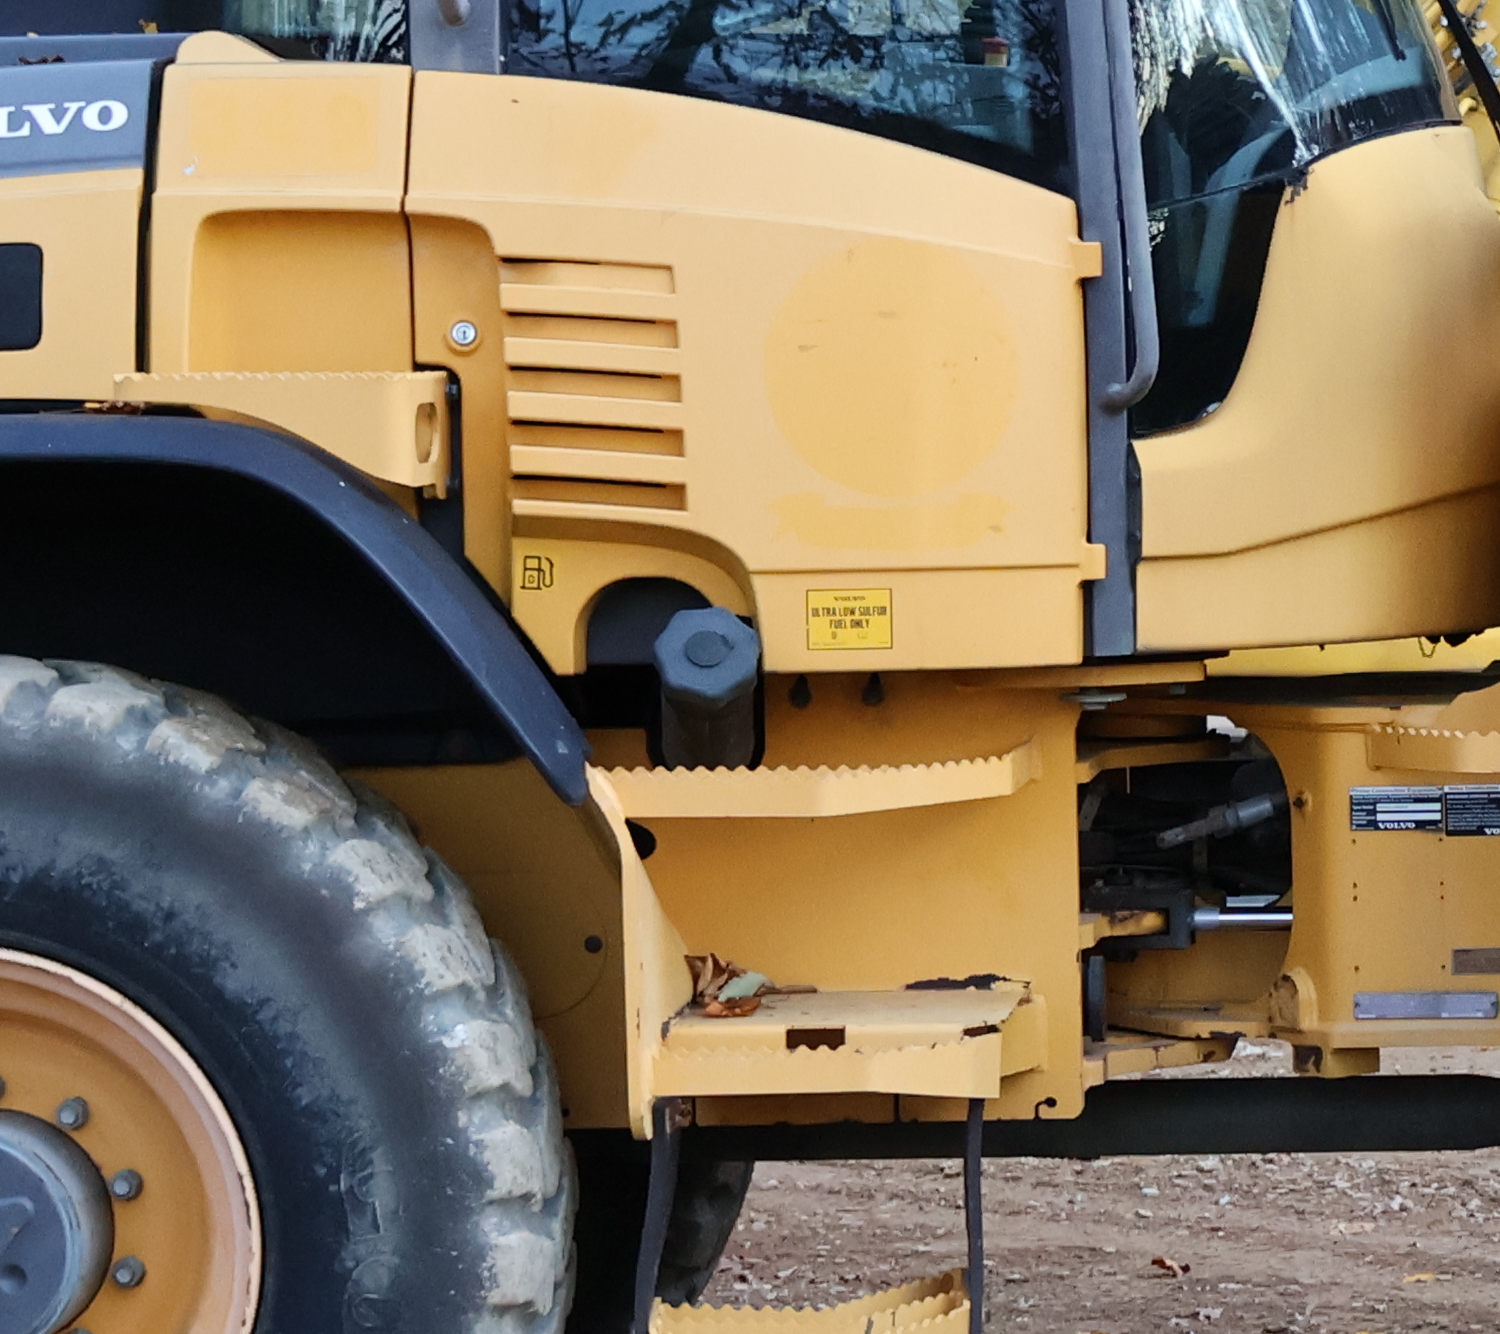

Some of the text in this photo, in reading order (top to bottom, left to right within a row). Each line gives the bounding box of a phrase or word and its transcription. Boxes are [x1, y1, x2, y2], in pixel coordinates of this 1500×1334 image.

[811, 605, 888, 617] ULTRA LOW SULFUR
[829, 618, 871, 629] FUEL ONLY
[1378, 822, 1417, 830] VOLVO
